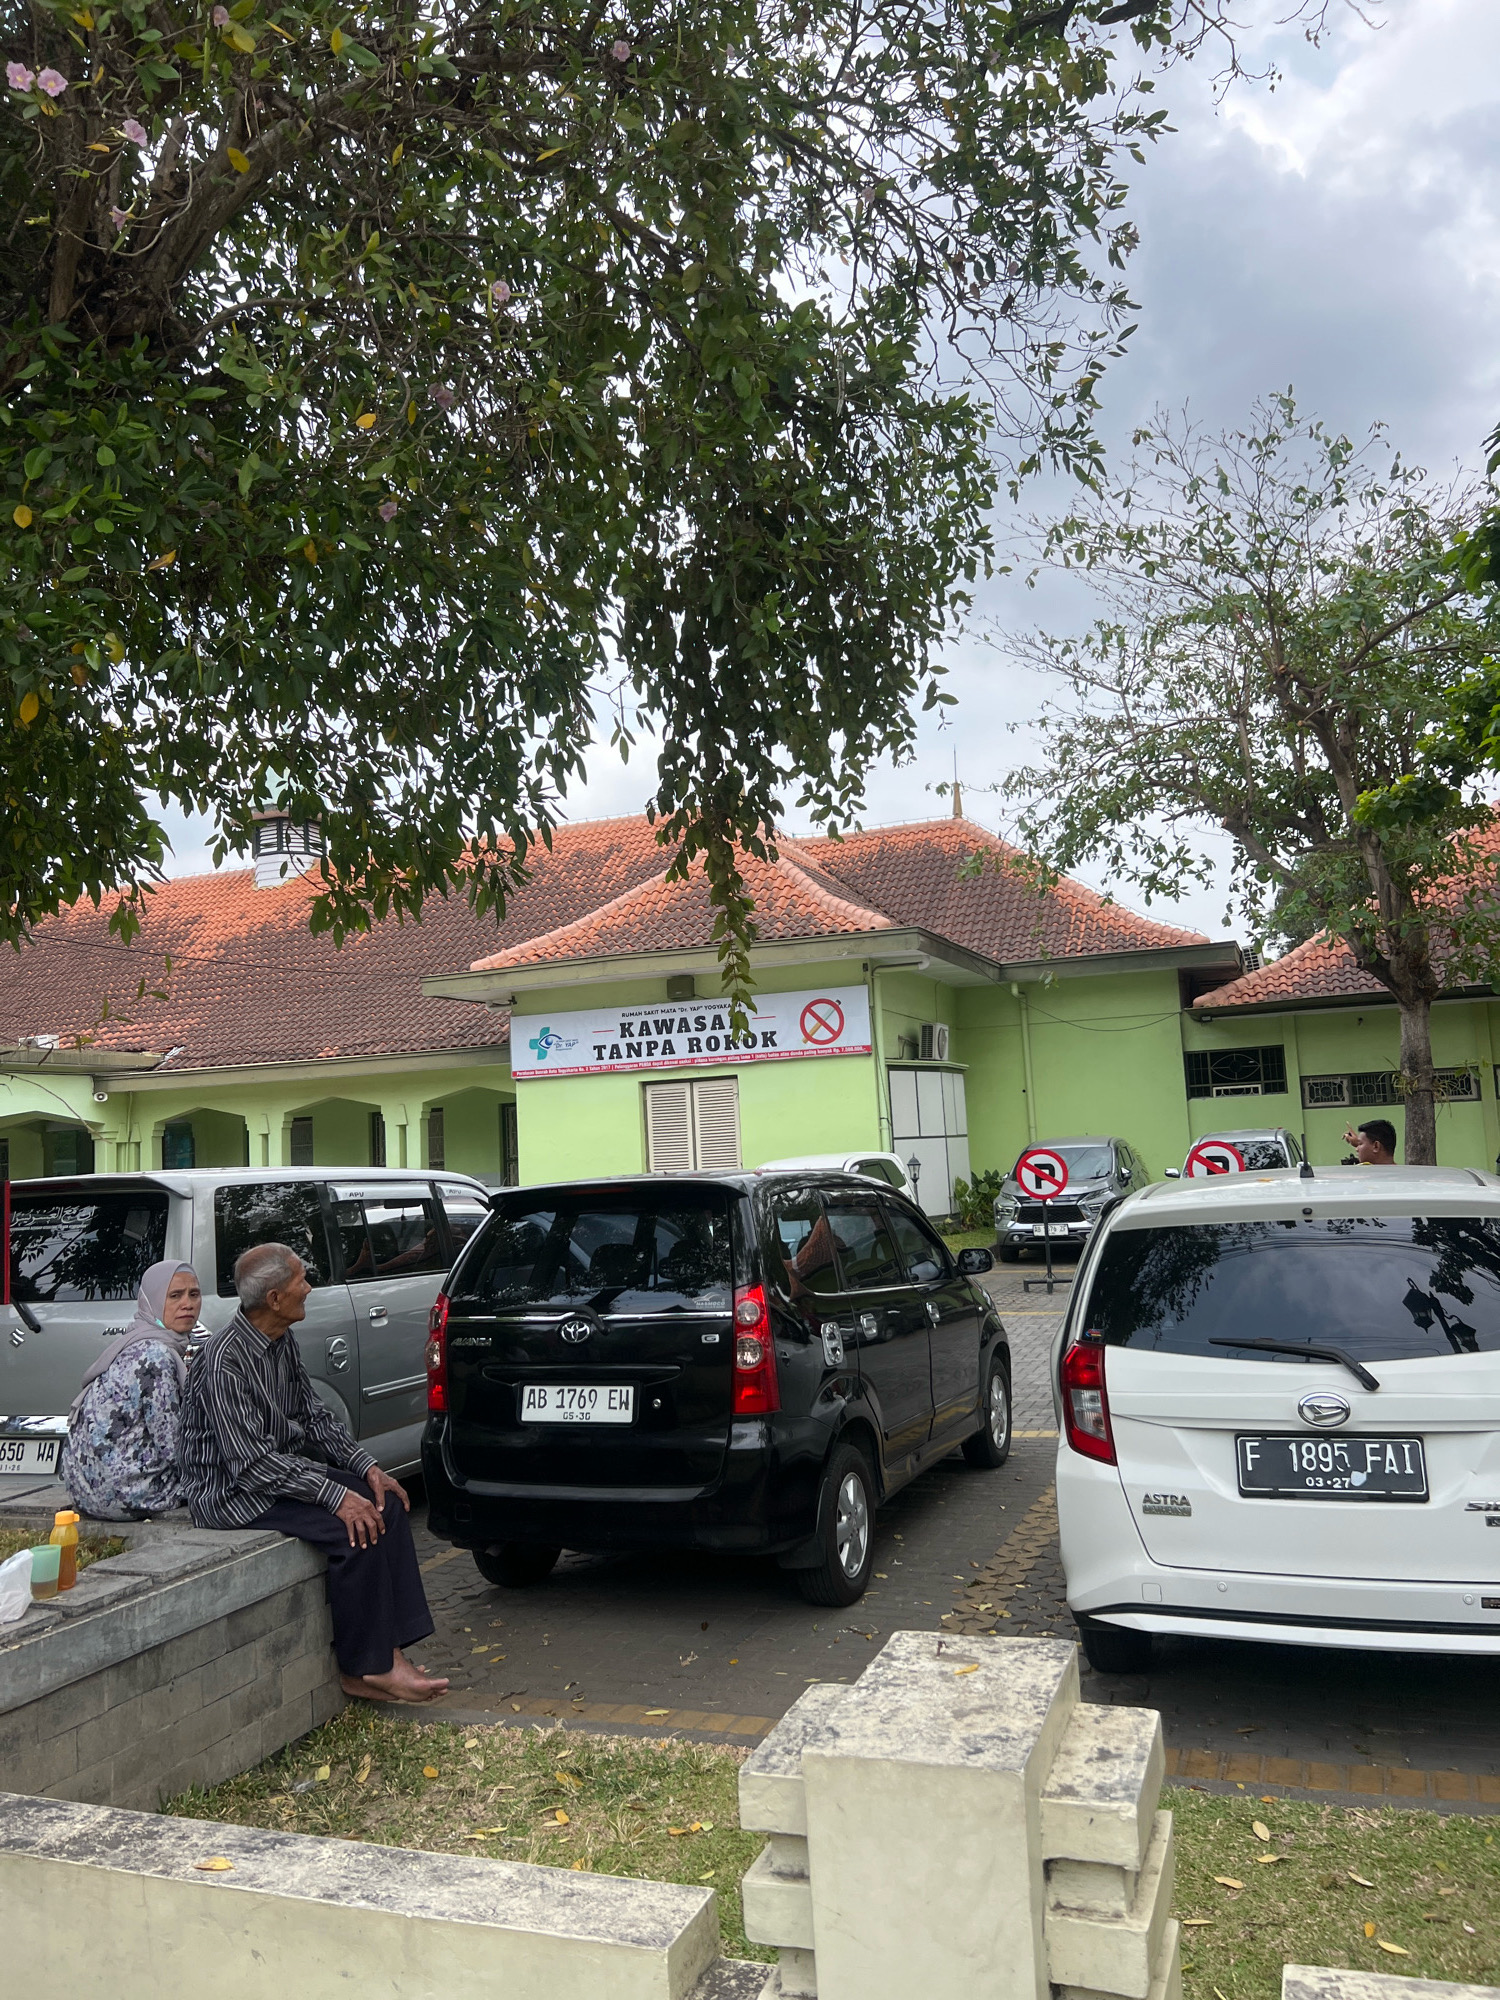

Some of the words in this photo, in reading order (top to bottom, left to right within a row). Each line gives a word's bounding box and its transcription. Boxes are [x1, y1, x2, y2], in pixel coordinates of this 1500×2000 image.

[704, 1002, 742, 1011] YOGYAKAA
[620, 1012, 746, 1038] KAWASA
[593, 1039, 676, 1061] TANPA
[688, 1031, 778, 1054] ROKOK
[1034, 1163, 1056, 1190] P
[451, 1337, 492, 1346] AVANZA
[526, 1388, 547, 1409] AB
[556, 1388, 598, 1409] 1769
[608, 1389, 630, 1411] EW
[37, 1442, 55, 1462] WA
[1245, 1442, 1261, 1471] F
[1288, 1442, 1351, 1473] 1895
[1364, 1443, 1414, 1475] FAI
[1142, 1492, 1191, 1506] ASTRA
